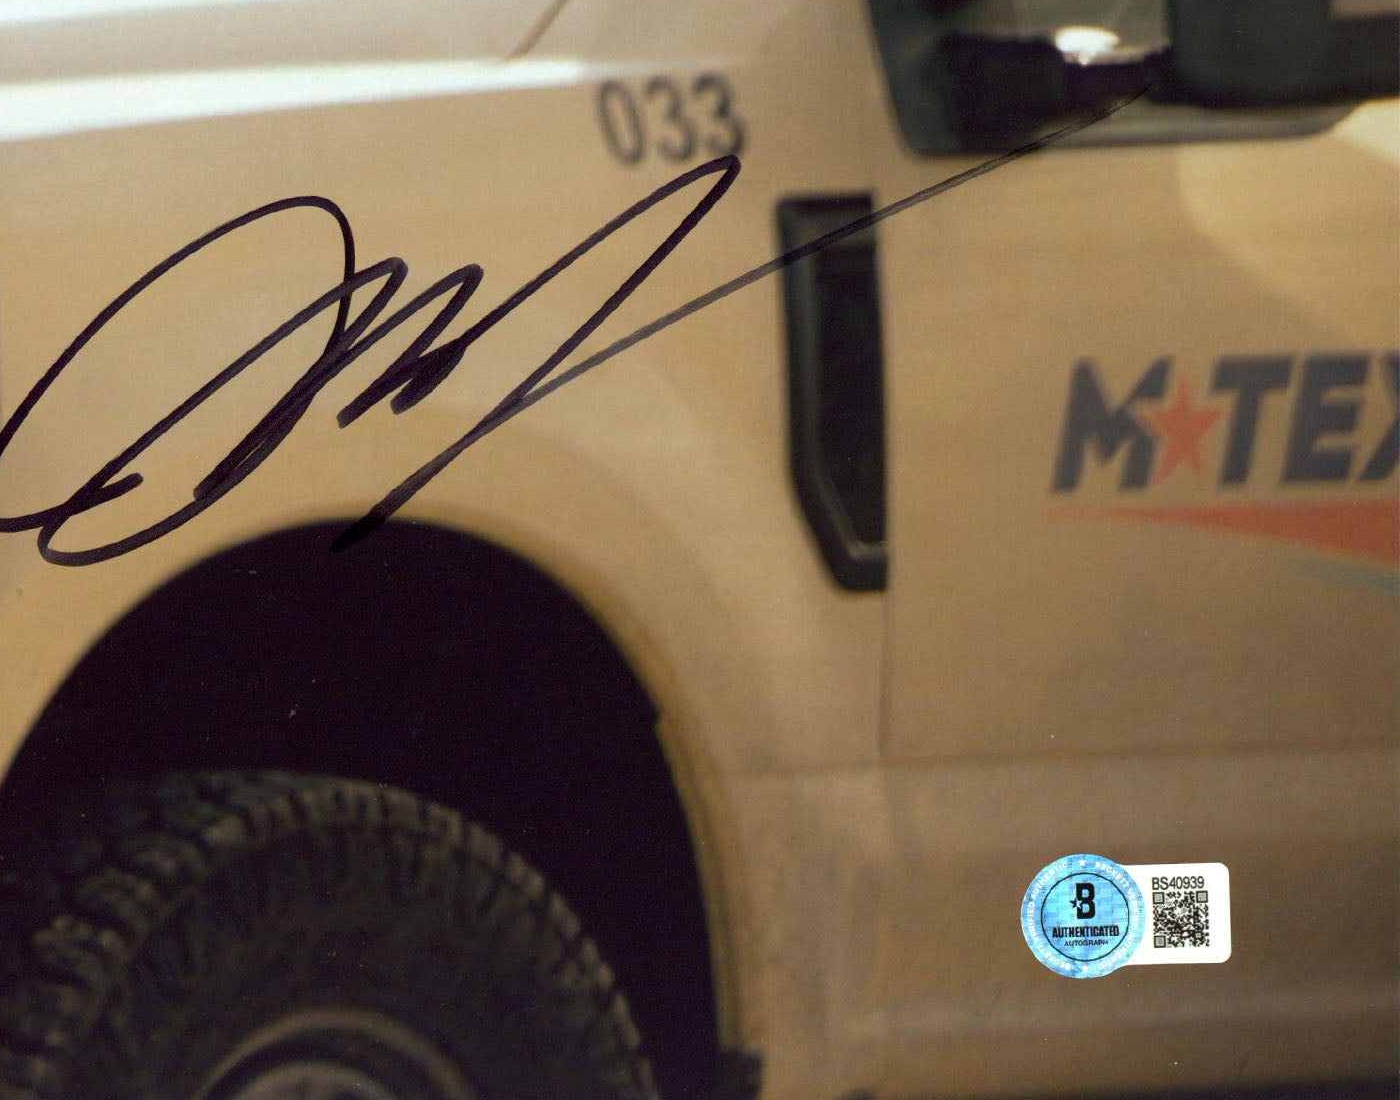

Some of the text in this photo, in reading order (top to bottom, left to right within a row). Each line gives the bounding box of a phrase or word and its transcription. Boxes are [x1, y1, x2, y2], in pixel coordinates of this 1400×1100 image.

[597, 72, 746, 166] 033
[1031, 861, 1068, 900] AUTHENTIC
[1095, 860, 1130, 888] BECKETT
[1152, 875, 1205, 891] BS40939
[1052, 925, 1120, 939] AUTHENTICATED
[1064, 939, 1109, 947] AUTOGRAPH
